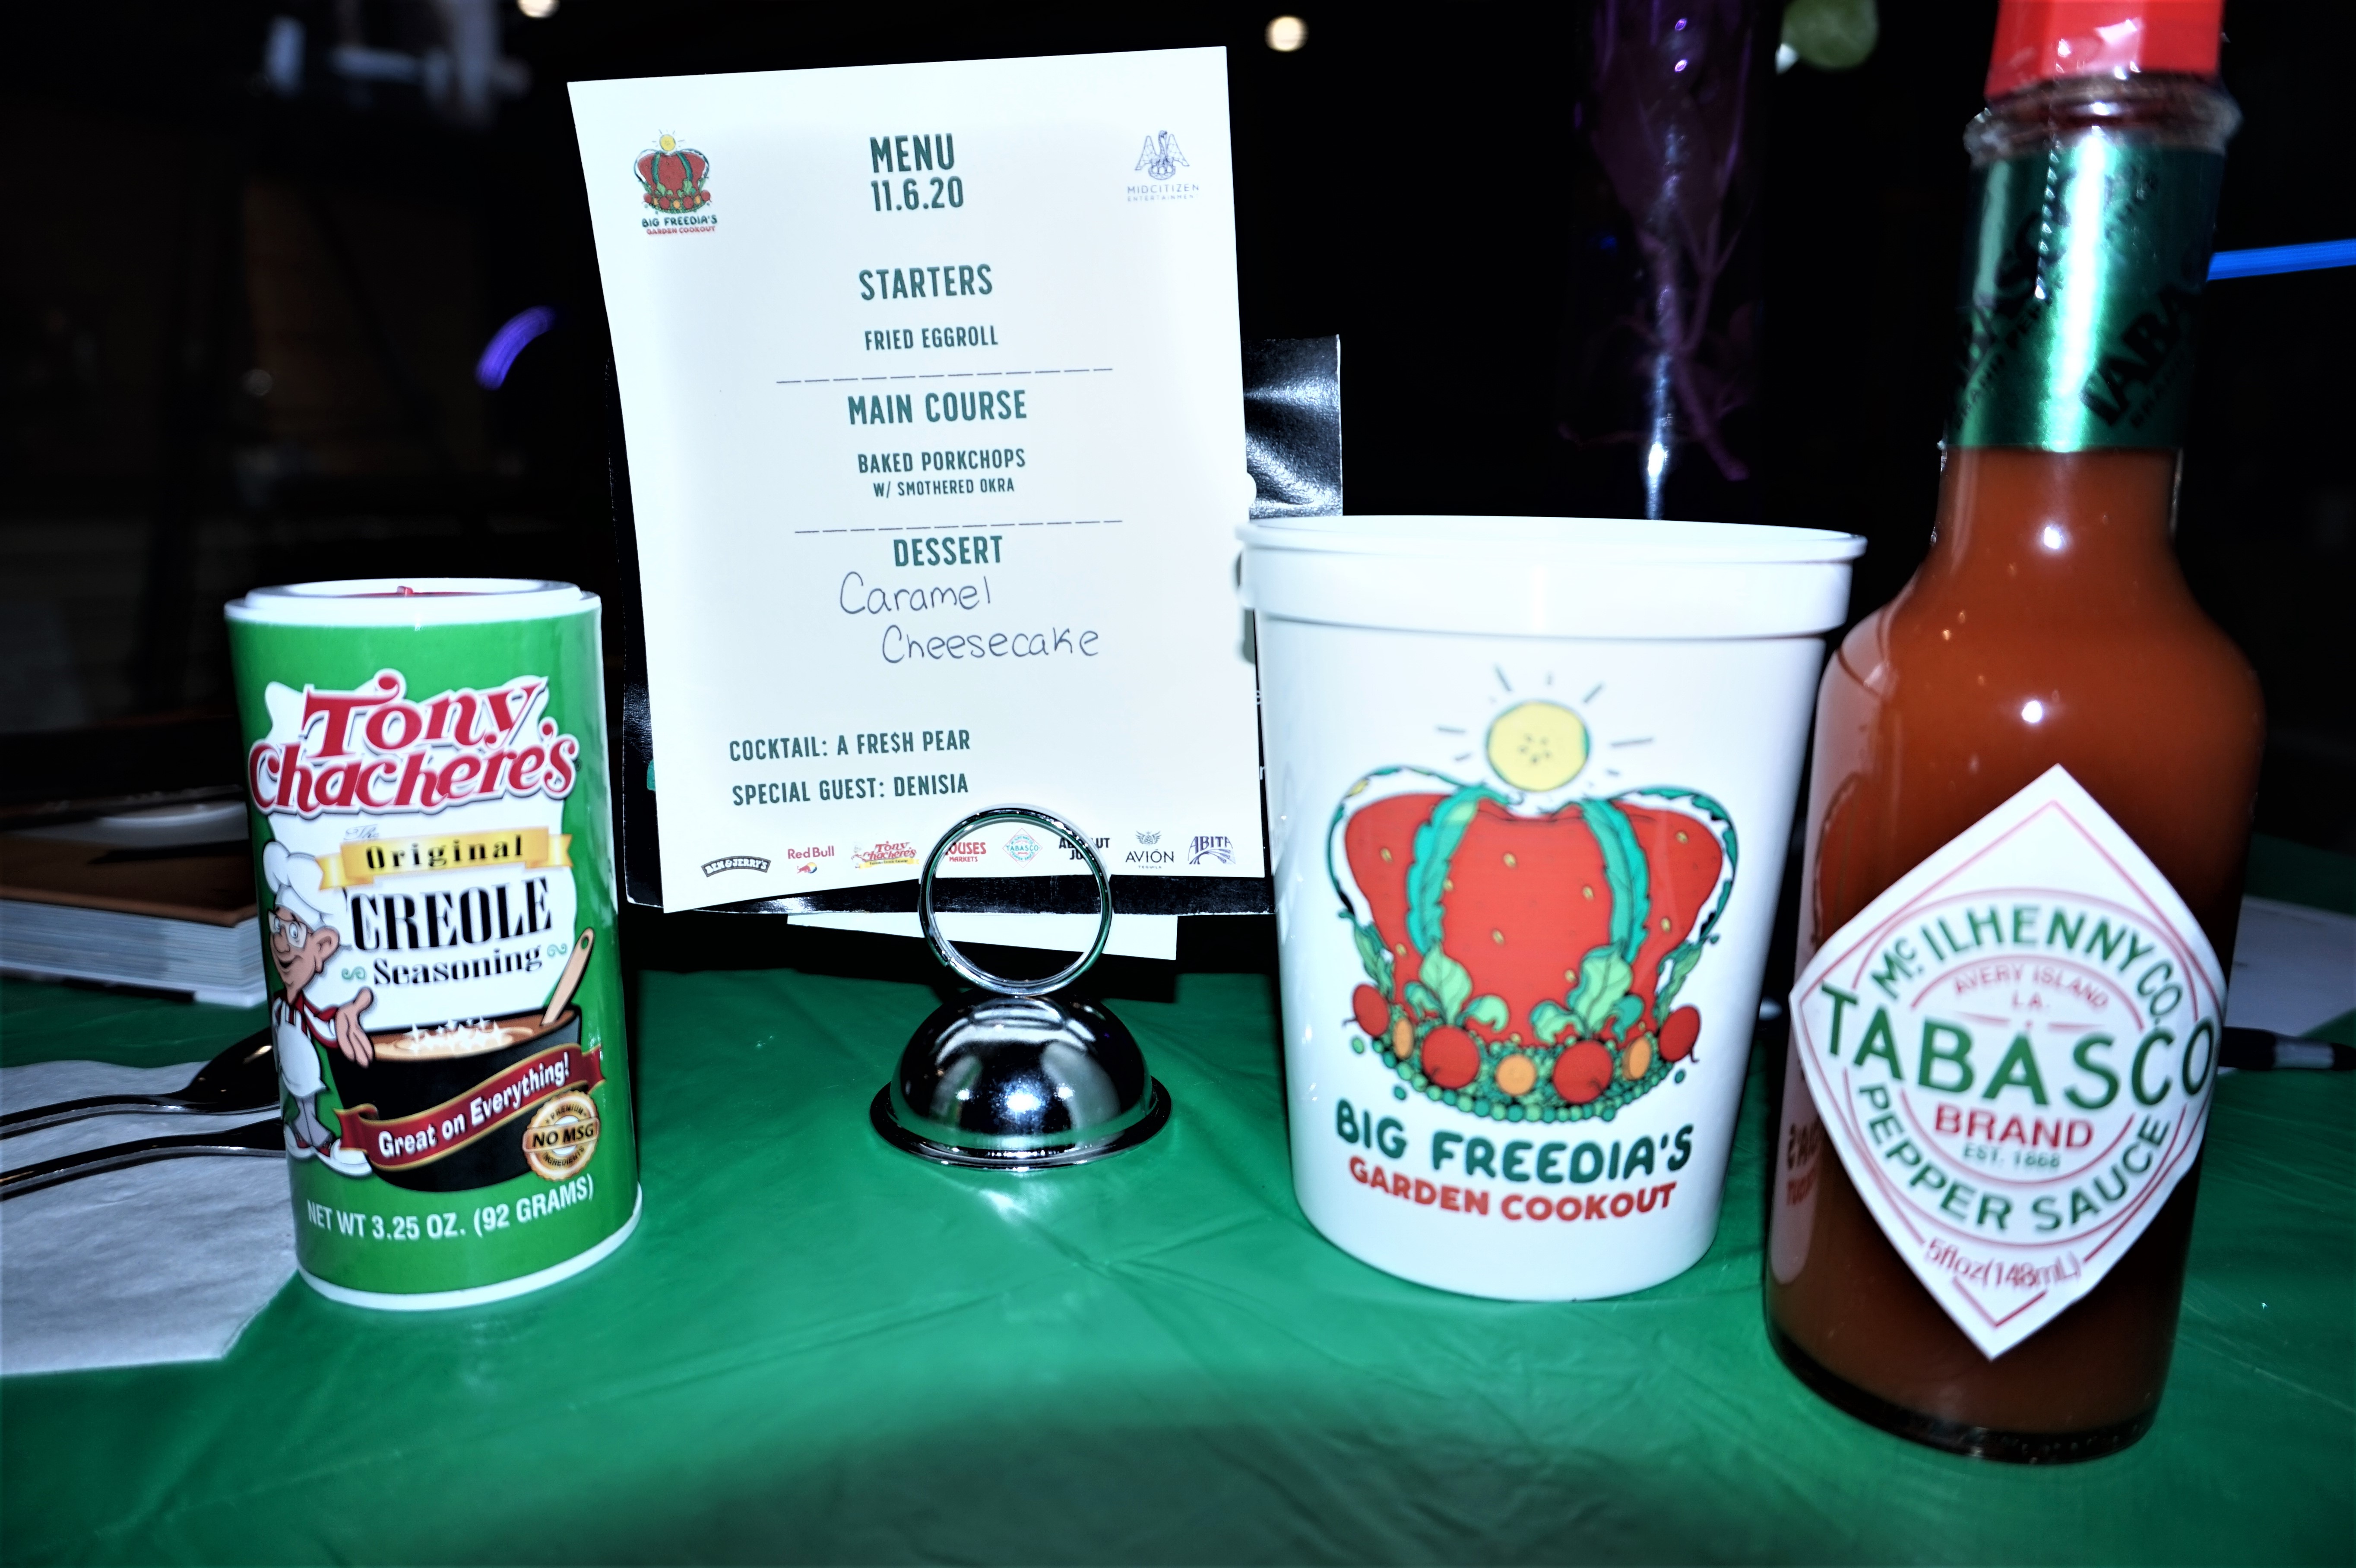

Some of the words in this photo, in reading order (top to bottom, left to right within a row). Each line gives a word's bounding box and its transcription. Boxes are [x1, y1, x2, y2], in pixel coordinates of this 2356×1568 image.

[869, 133, 955, 173] MENU
[871, 175, 965, 212] 11.6.20
[1127, 183, 1199, 194] MIDCITIZEN
[642, 218, 659, 228] BIG
[664, 215, 718, 226] FREEDIA'S
[859, 264, 994, 301] STARTERS
[864, 329, 914, 351] FRIED
[921, 326, 998, 348] EGGROLL
[847, 395, 914, 426] MAIN
[925, 390, 1027, 423] COURSE
[858, 452, 914, 474] BAKED
[921, 449, 1026, 471] PORKCHOPS
[873, 481, 891, 498] W/
[898, 479, 975, 496] SMOTHERED
[980, 477, 1015, 493] OKRA
[893, 535, 1003, 566] DESSERT
[839, 571, 991, 614] Caramel
[882, 624, 1099, 663] Cheesecake
[301, 675, 545, 759] Tony
[729, 736, 828, 762] COCKTAIL:
[837, 735, 849, 756] A
[923, 729, 971, 752] PEAR
[250, 722, 576, 812] Chachere's
[732, 782, 811, 806] SPECIAL
[819, 777, 885, 801] GUEST:
[893, 773, 969, 797] DENISIA
[366, 834, 523, 870] Original
[787, 847, 811, 860] Red
[813, 845, 835, 858] Bull
[860, 847, 917, 862] Chachere's
[874, 841, 910, 853] Tony
[946, 842, 987, 856] OUSES
[1125, 848, 1174, 863] AVIÓN
[1188, 836, 1233, 861] ABITA
[350, 877, 552, 951] CREOLE
[373, 943, 543, 986] Seasoning
[1954, 964, 2024, 993] AVERY
[2033, 965, 2109, 1007] ISLAND
[1821, 979, 2214, 1110] TABASCO
[379, 1124, 437, 1158] Great
[442, 1113, 466, 1138] on
[469, 1051, 570, 1128] Everything!
[550, 1103, 584, 1120] PREMIUM
[532, 1130, 558, 1148] NO
[562, 1123, 594, 1144] MSG
[1336, 1099, 1408, 1160] BIG
[1431, 1123, 1695, 1185] FREEDIA'S
[1935, 1103, 2095, 1151] BRAND
[1859, 1082, 2012, 1232] PEPPER
[2031, 1113, 2169, 1233] SAUCE
[1962, 1143, 2005, 1169] EST.
[1348, 1155, 1491, 1217] GARDEN
[1500, 1181, 1678, 1222] COOKOUT
[307, 1200, 333, 1230] NET
[337, 1212, 366, 1238] WT
[371, 1213, 420, 1240] 3.25
[426, 1212, 466, 1239] OZ.
[473, 1205, 511, 1239] (92
[516, 1174, 594, 1222] GRAMS)
